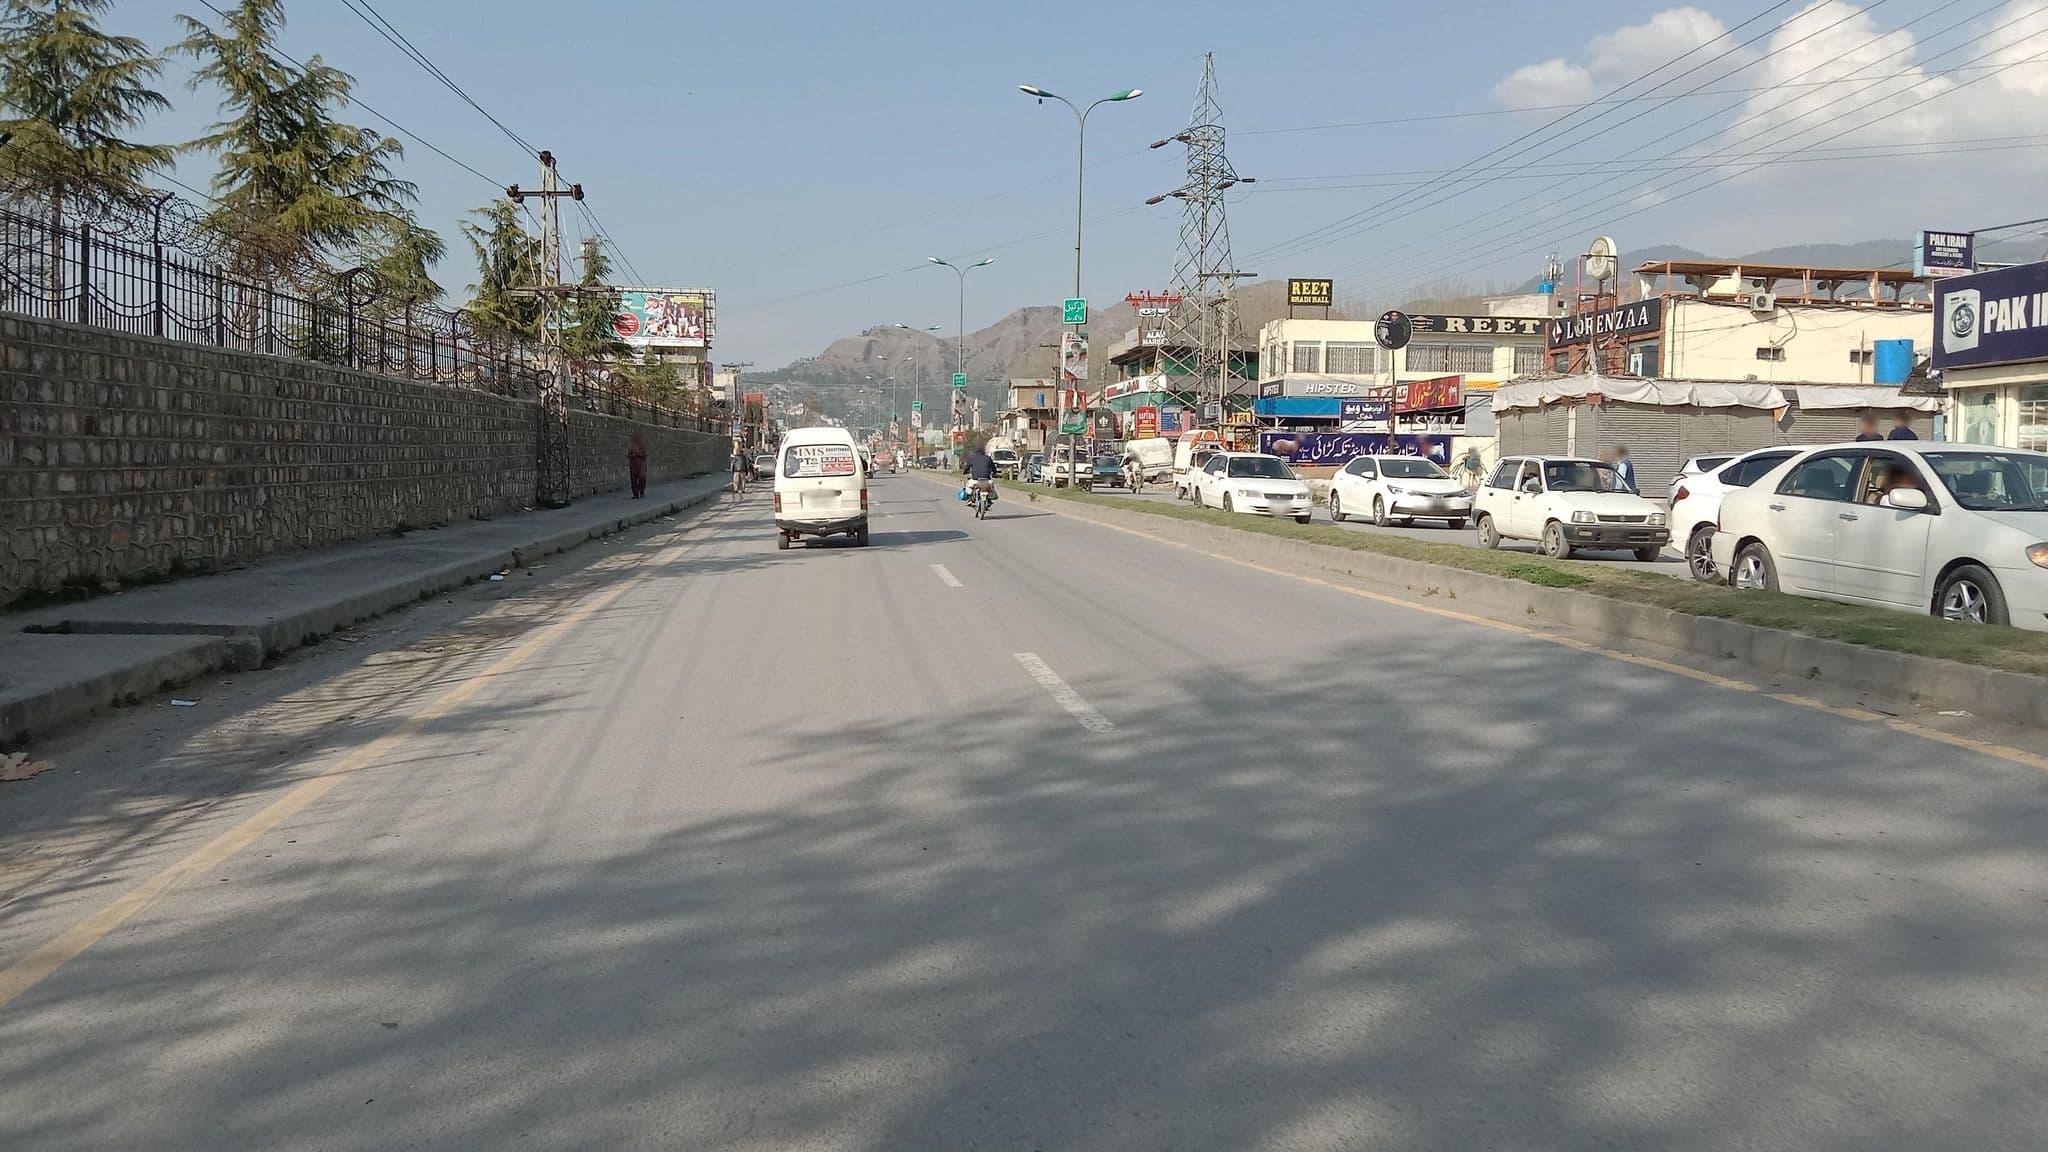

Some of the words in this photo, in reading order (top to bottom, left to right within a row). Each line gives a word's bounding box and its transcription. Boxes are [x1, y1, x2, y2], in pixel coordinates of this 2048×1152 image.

[1930, 234, 1946, 247] PAK
[1947, 235, 1967, 249] IRAN
[1292, 282, 1329, 295] REET
[1984, 296, 2027, 334] PAK
[2032, 291, 2048, 328] I
[1445, 317, 1541, 334] REET
[1566, 306, 1649, 339] LORENZAA
[1305, 383, 1358, 395] HIPSTER
